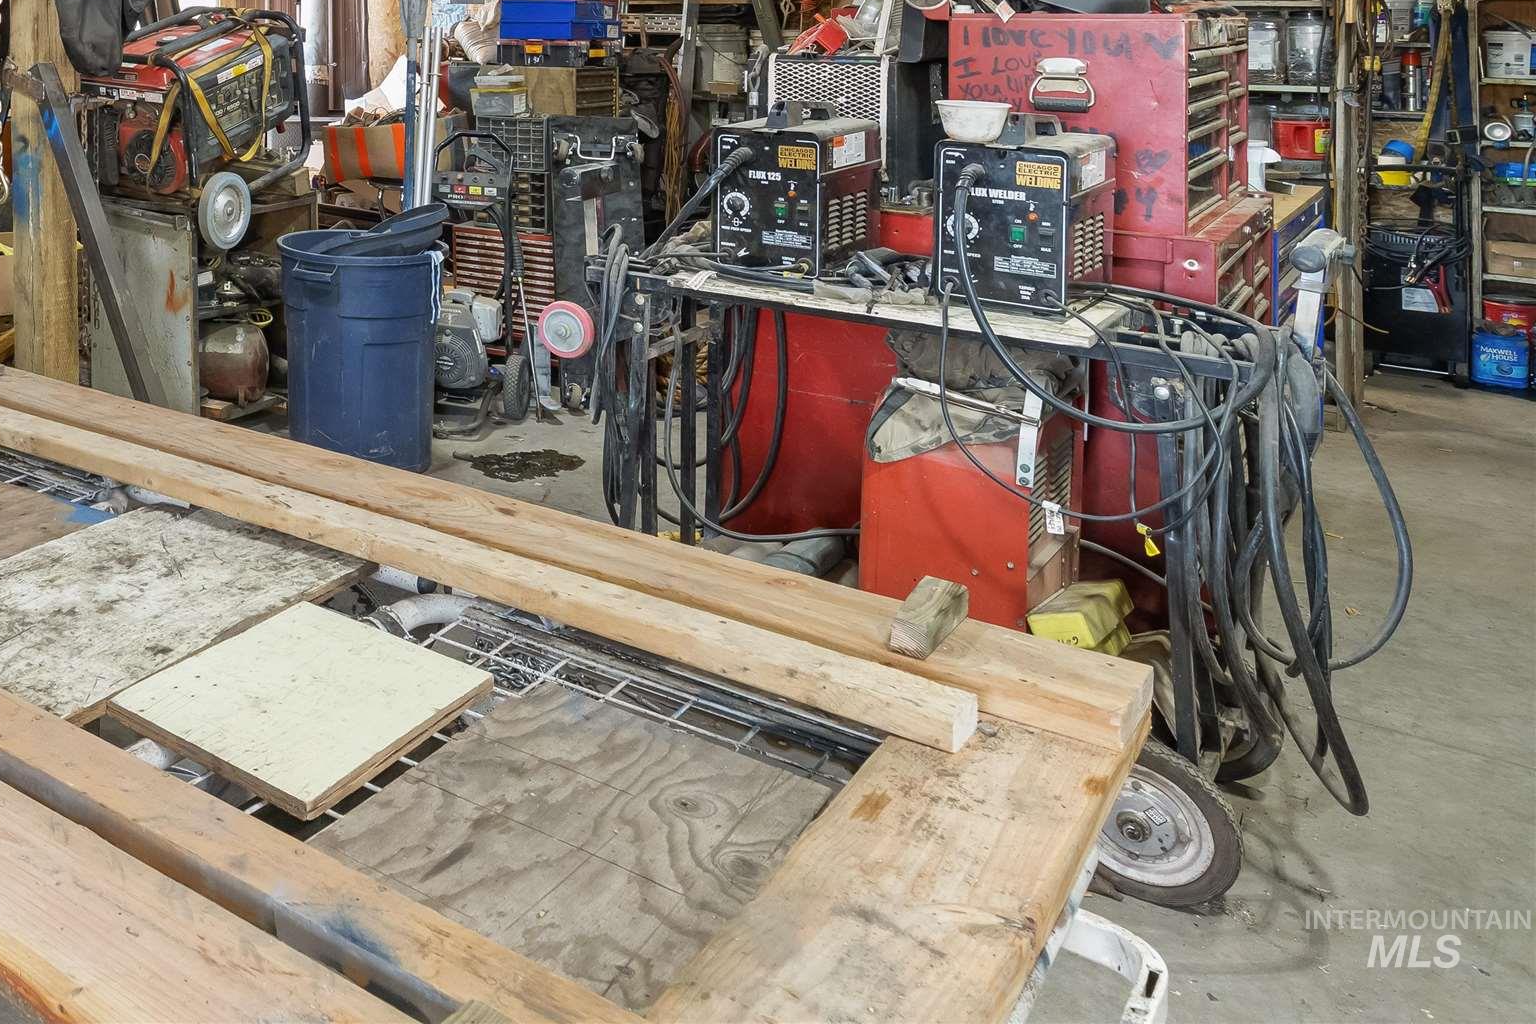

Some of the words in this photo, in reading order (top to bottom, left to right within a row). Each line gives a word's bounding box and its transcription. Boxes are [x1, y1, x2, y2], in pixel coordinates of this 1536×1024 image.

[778, 158, 816, 170] WELDING
[748, 170, 766, 181] FLUX
[767, 171, 782, 182] 125
[1018, 167, 1059, 177] ELECTRIC
[1016, 175, 1061, 190] WELDING
[988, 188, 1027, 201] WELDER
[1480, 345, 1519, 357] MAXWELL
[1491, 353, 1518, 362] HOUSE
